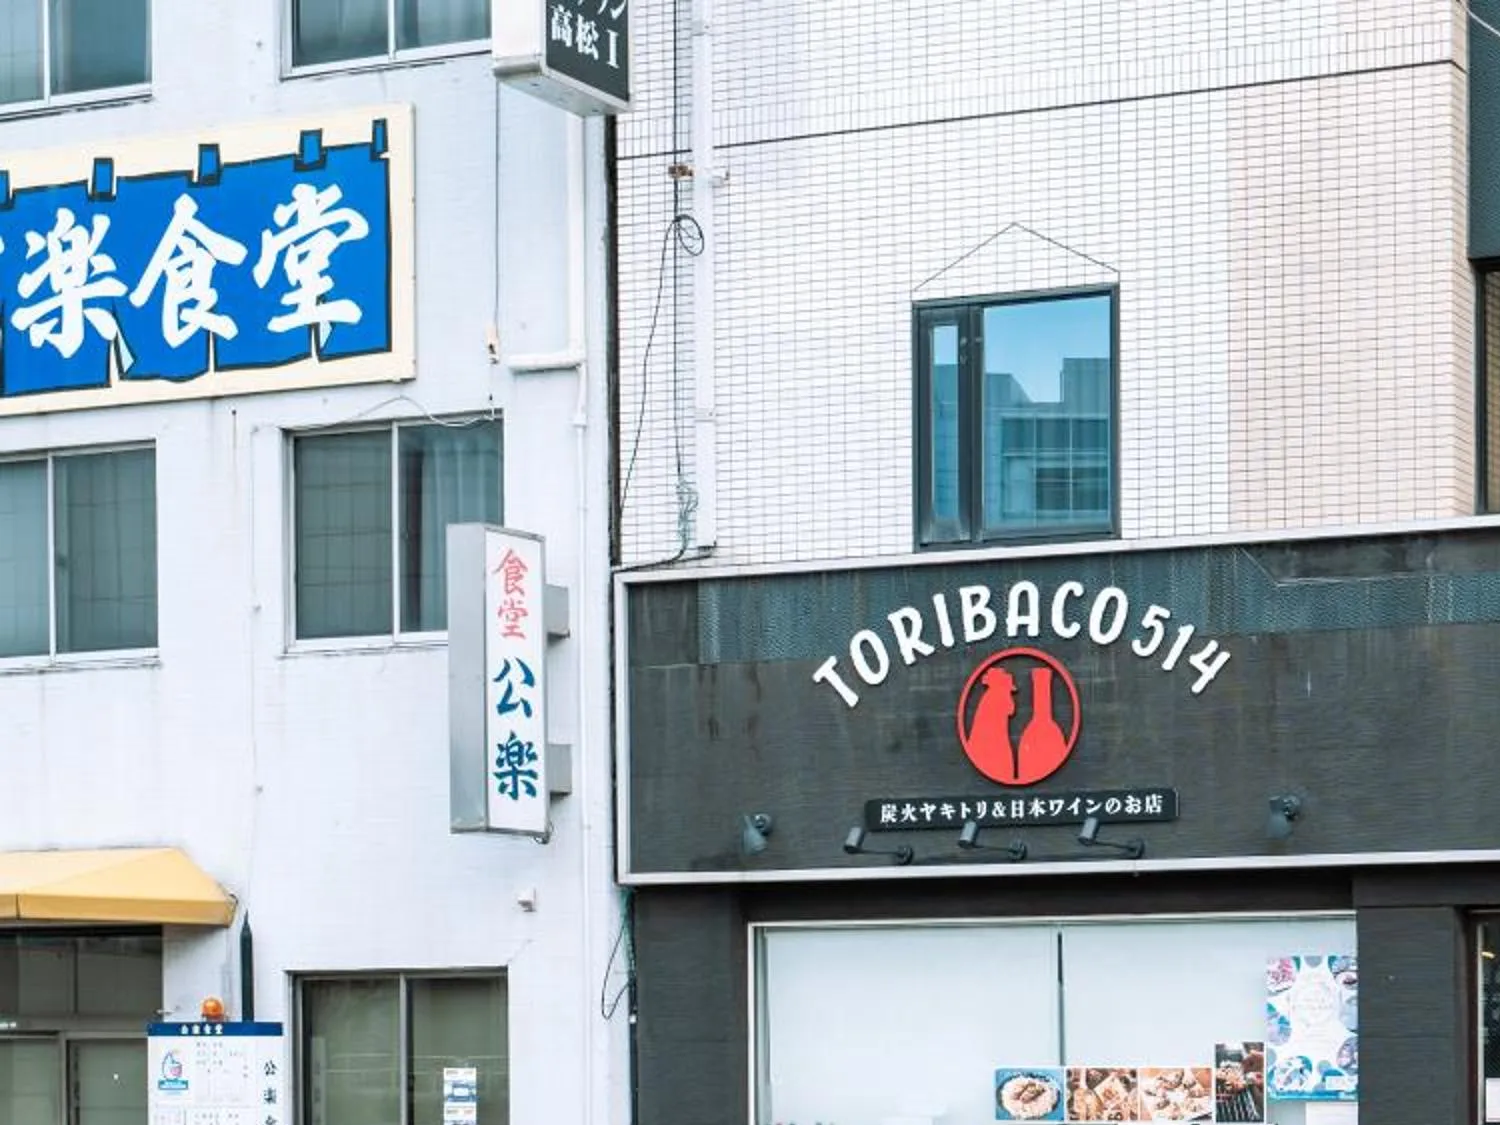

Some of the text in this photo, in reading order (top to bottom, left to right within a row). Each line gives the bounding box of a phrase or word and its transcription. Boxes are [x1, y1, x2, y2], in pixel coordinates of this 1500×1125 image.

[0, 184, 369, 358] 楽食堂
[493, 549, 539, 801] 食堂 公楽
[813, 580, 1231, 708] TORIBACO514
[880, 794, 1163, 823] 炭火ヤキトリ&日本ワインのお店
